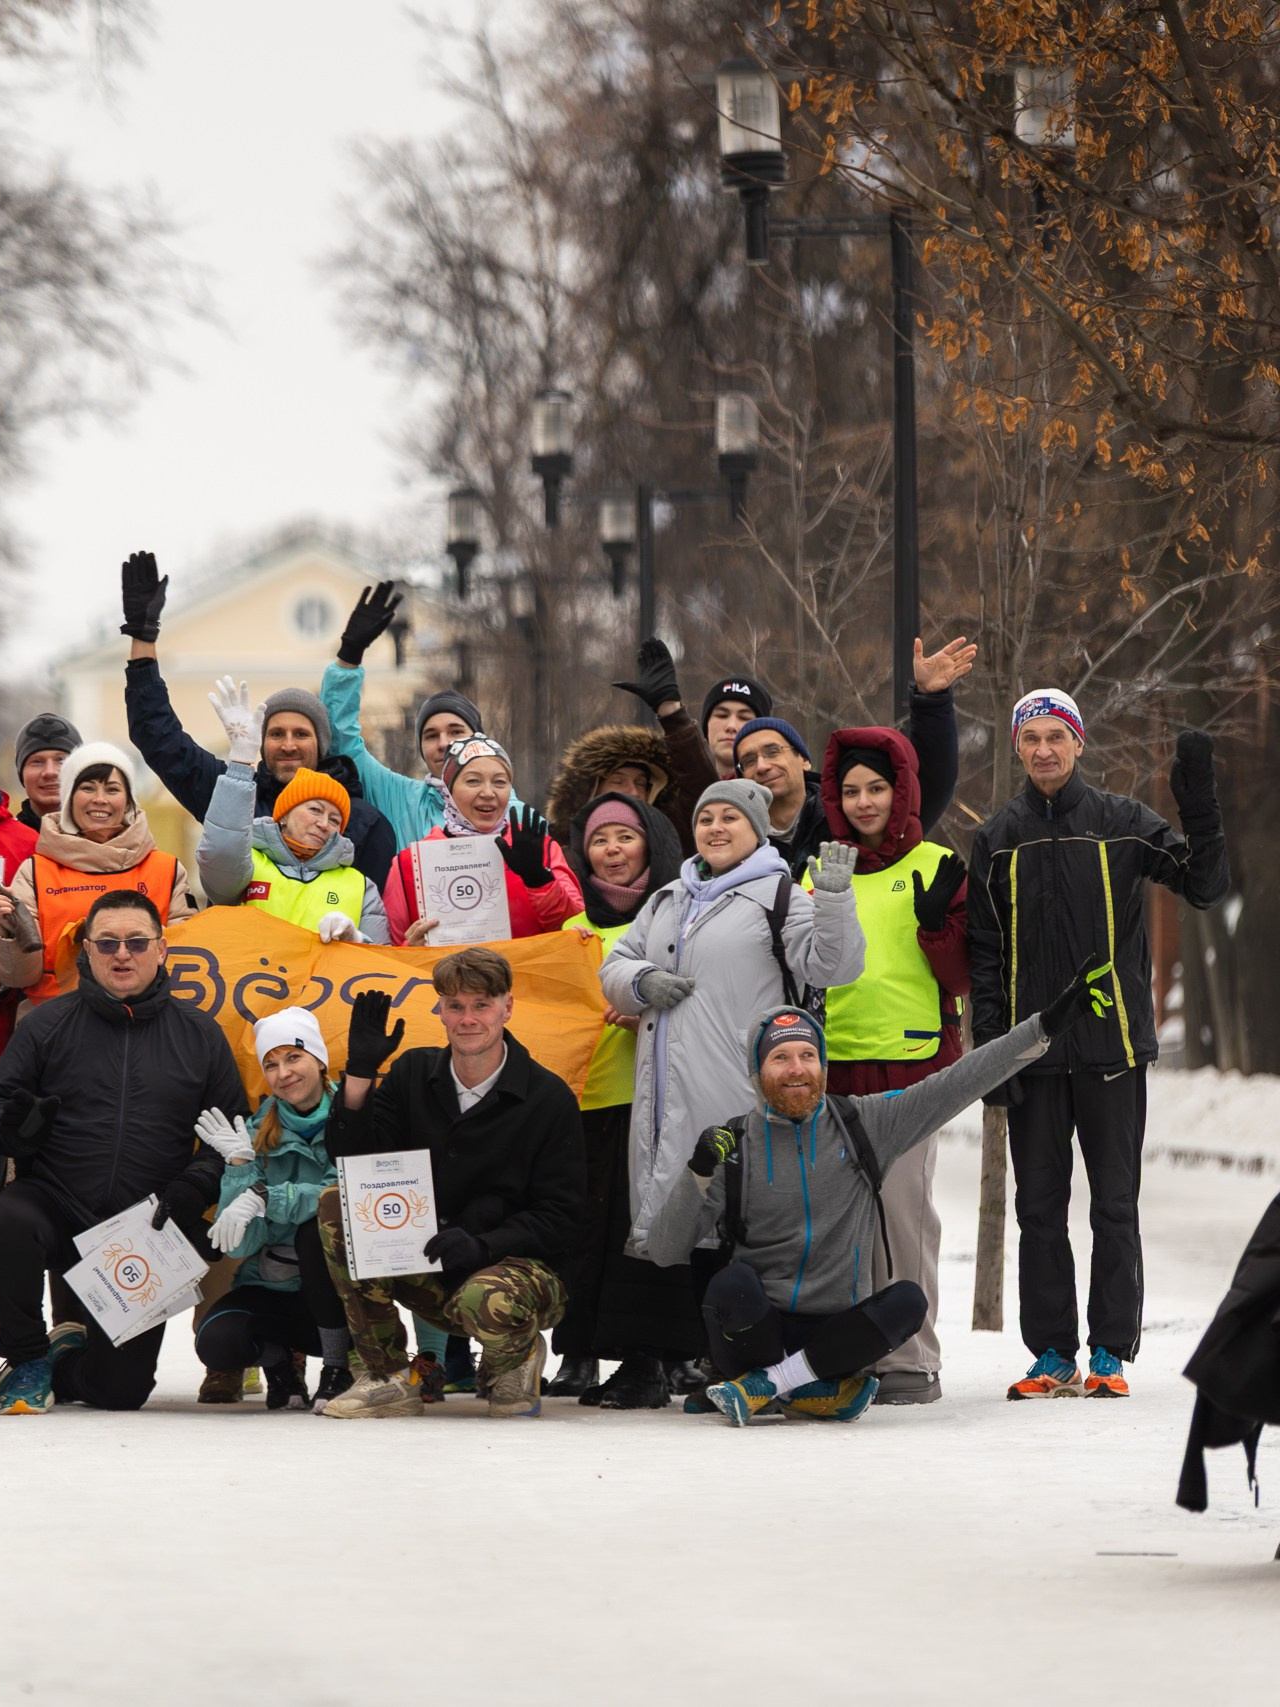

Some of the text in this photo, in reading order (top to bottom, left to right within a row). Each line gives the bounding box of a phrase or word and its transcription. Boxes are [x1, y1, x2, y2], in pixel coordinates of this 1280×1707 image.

[722, 682, 751, 695] FILA
[434, 861, 491, 872] Поздравляем!
[45, 884, 107, 896] Организатор
[456, 885, 474, 897] 50
[360, 1178, 419, 1190] Поздравляем!
[382, 1203, 401, 1215] 50
[122, 1265, 139, 1283] 50
[92, 1266, 130, 1314] Поздравляем!
